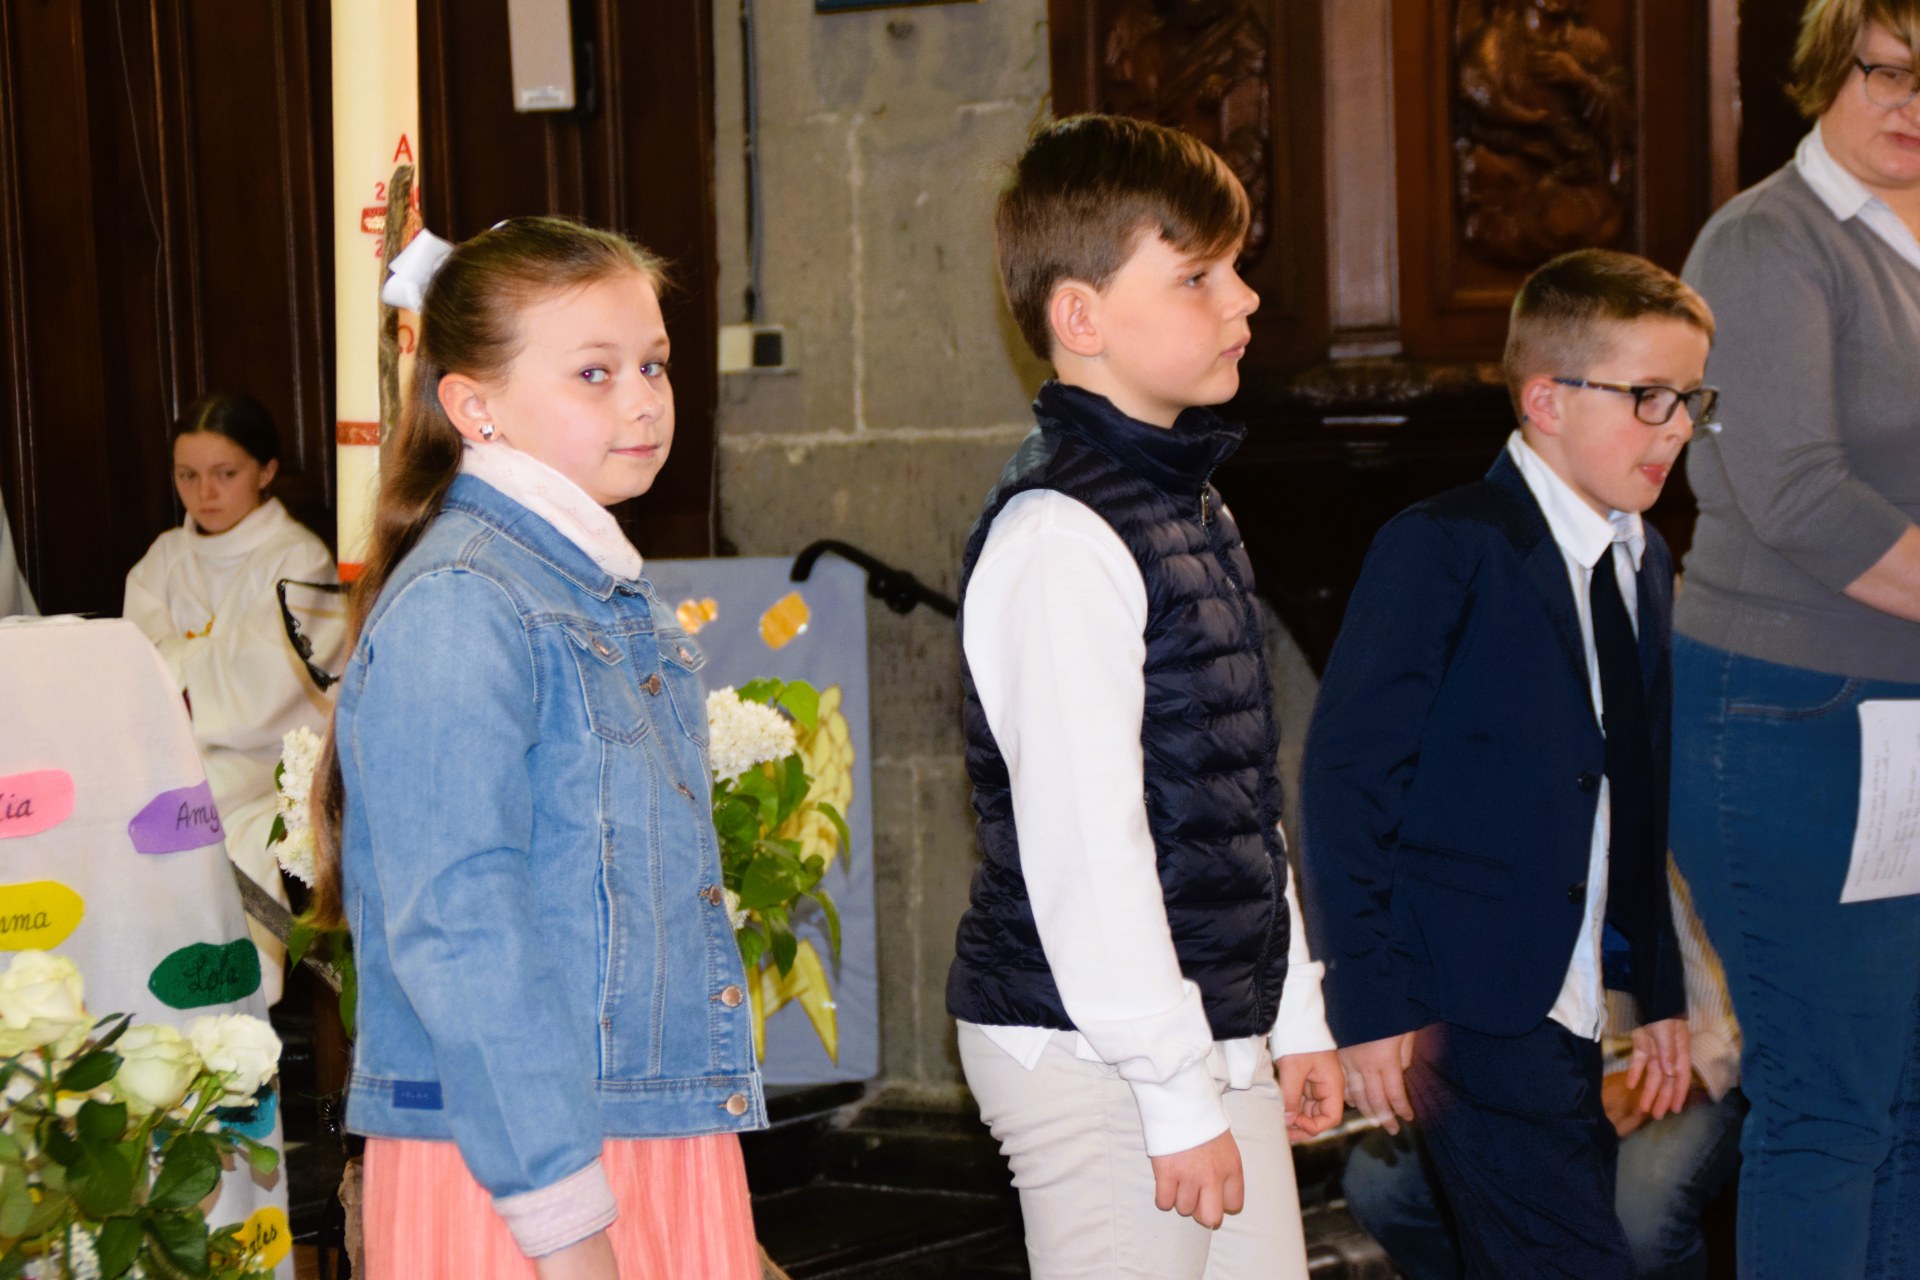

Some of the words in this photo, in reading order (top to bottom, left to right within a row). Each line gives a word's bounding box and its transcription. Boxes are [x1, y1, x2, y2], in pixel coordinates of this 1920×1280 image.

[393, 133, 413, 163] A
[374, 181, 386, 201] 2
[175, 801, 220, 834] Amy
[183, 953, 240, 992] Lola
